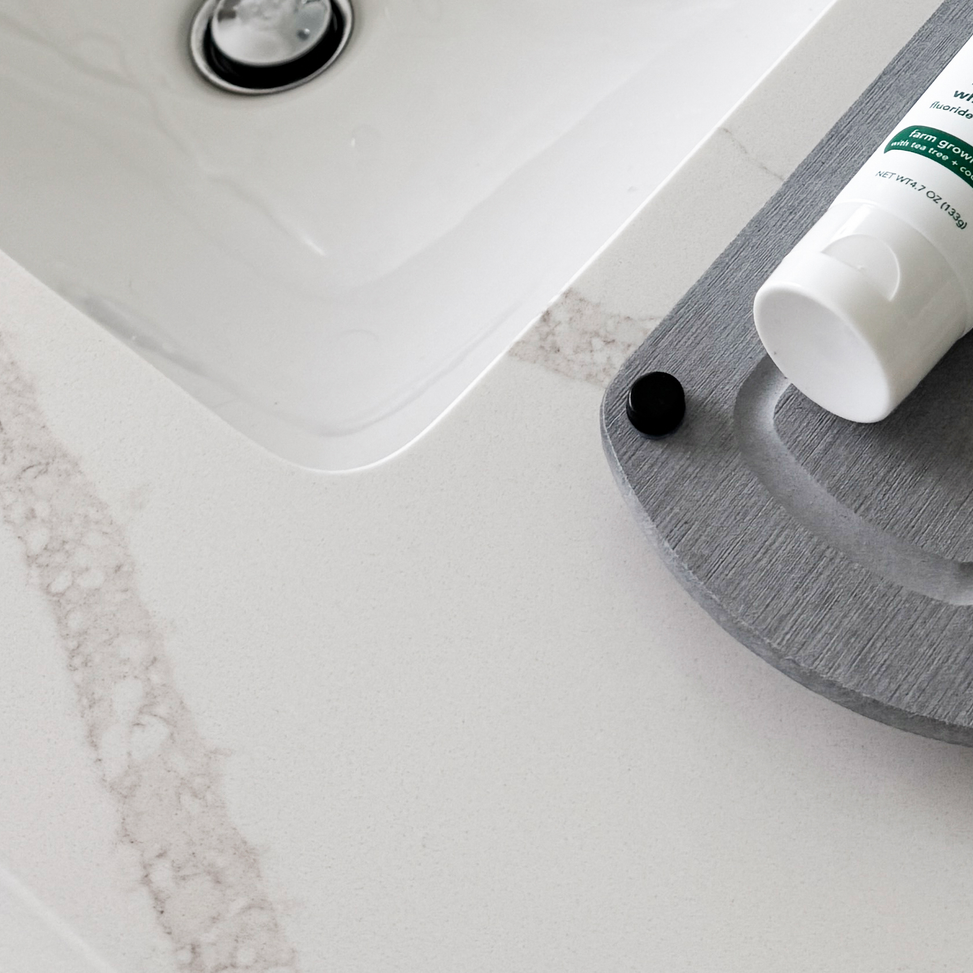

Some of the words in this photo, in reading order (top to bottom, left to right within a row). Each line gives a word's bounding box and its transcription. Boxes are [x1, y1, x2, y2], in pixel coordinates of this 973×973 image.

[929, 101, 973, 120] fluoride
[909, 129, 937, 143] farm
[890, 139, 910, 148] with
[910, 142, 927, 152] tea
[928, 147, 949, 161] tree
[875, 170, 897, 180] NET
[926, 190, 943, 204] OZ
[940, 201, 968, 230] (133g)
